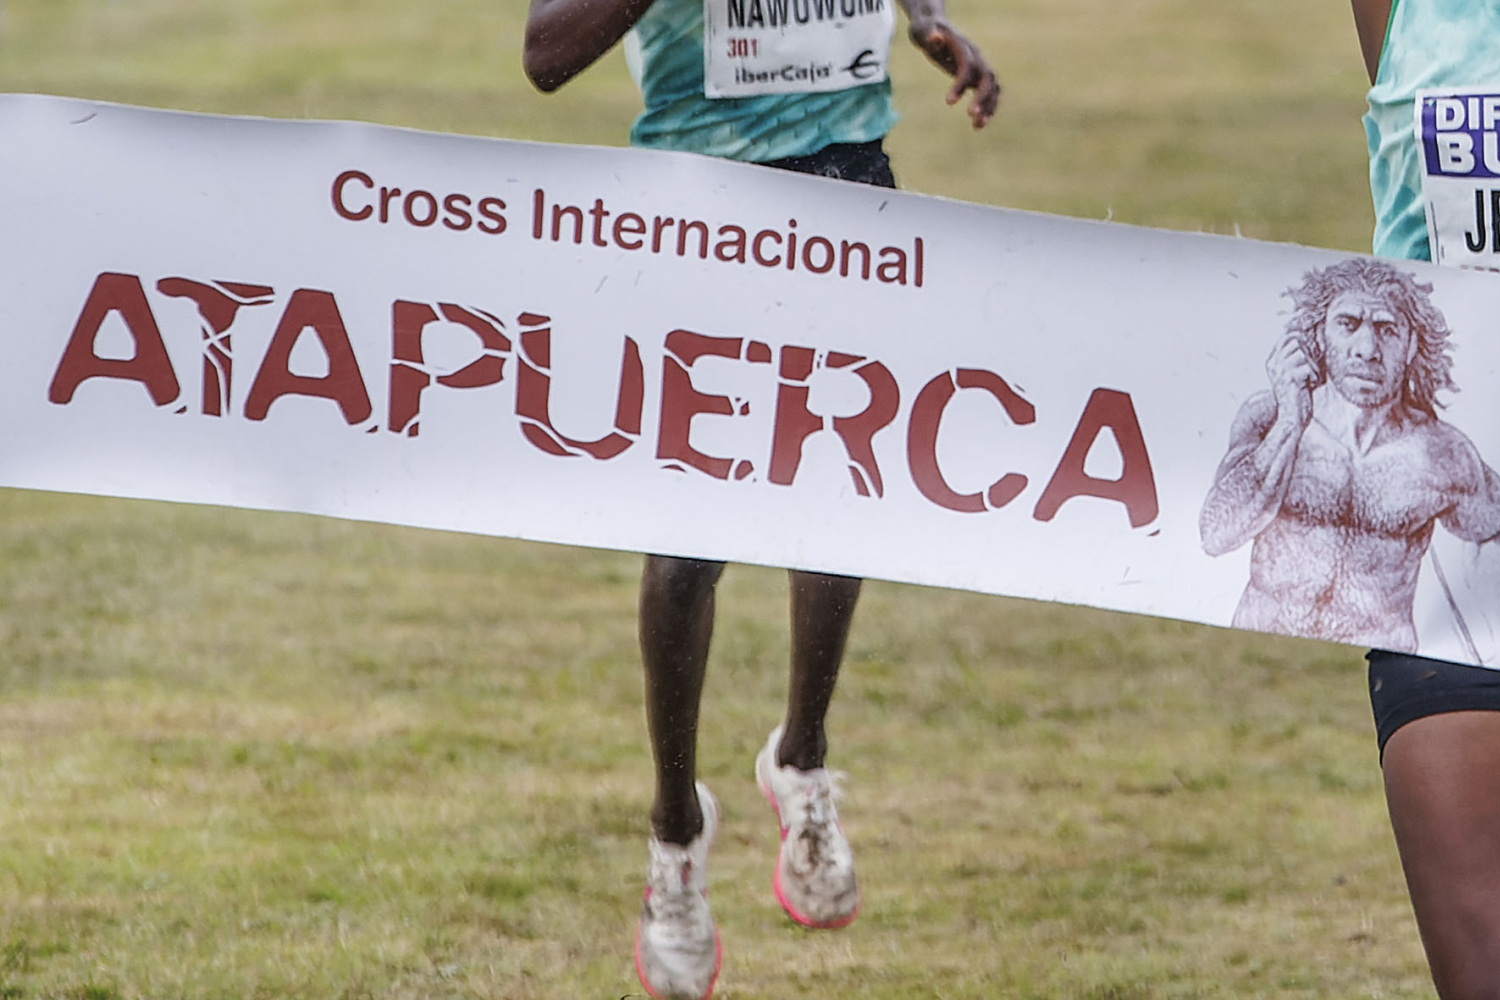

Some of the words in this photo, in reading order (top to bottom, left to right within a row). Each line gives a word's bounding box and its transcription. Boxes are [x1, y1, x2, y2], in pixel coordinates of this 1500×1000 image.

[727, 38, 758, 59] 301
[331, 169, 508, 235] Cross
[533, 188, 925, 288] Internacional
[47, 270, 1162, 536] ATAPUERCA
